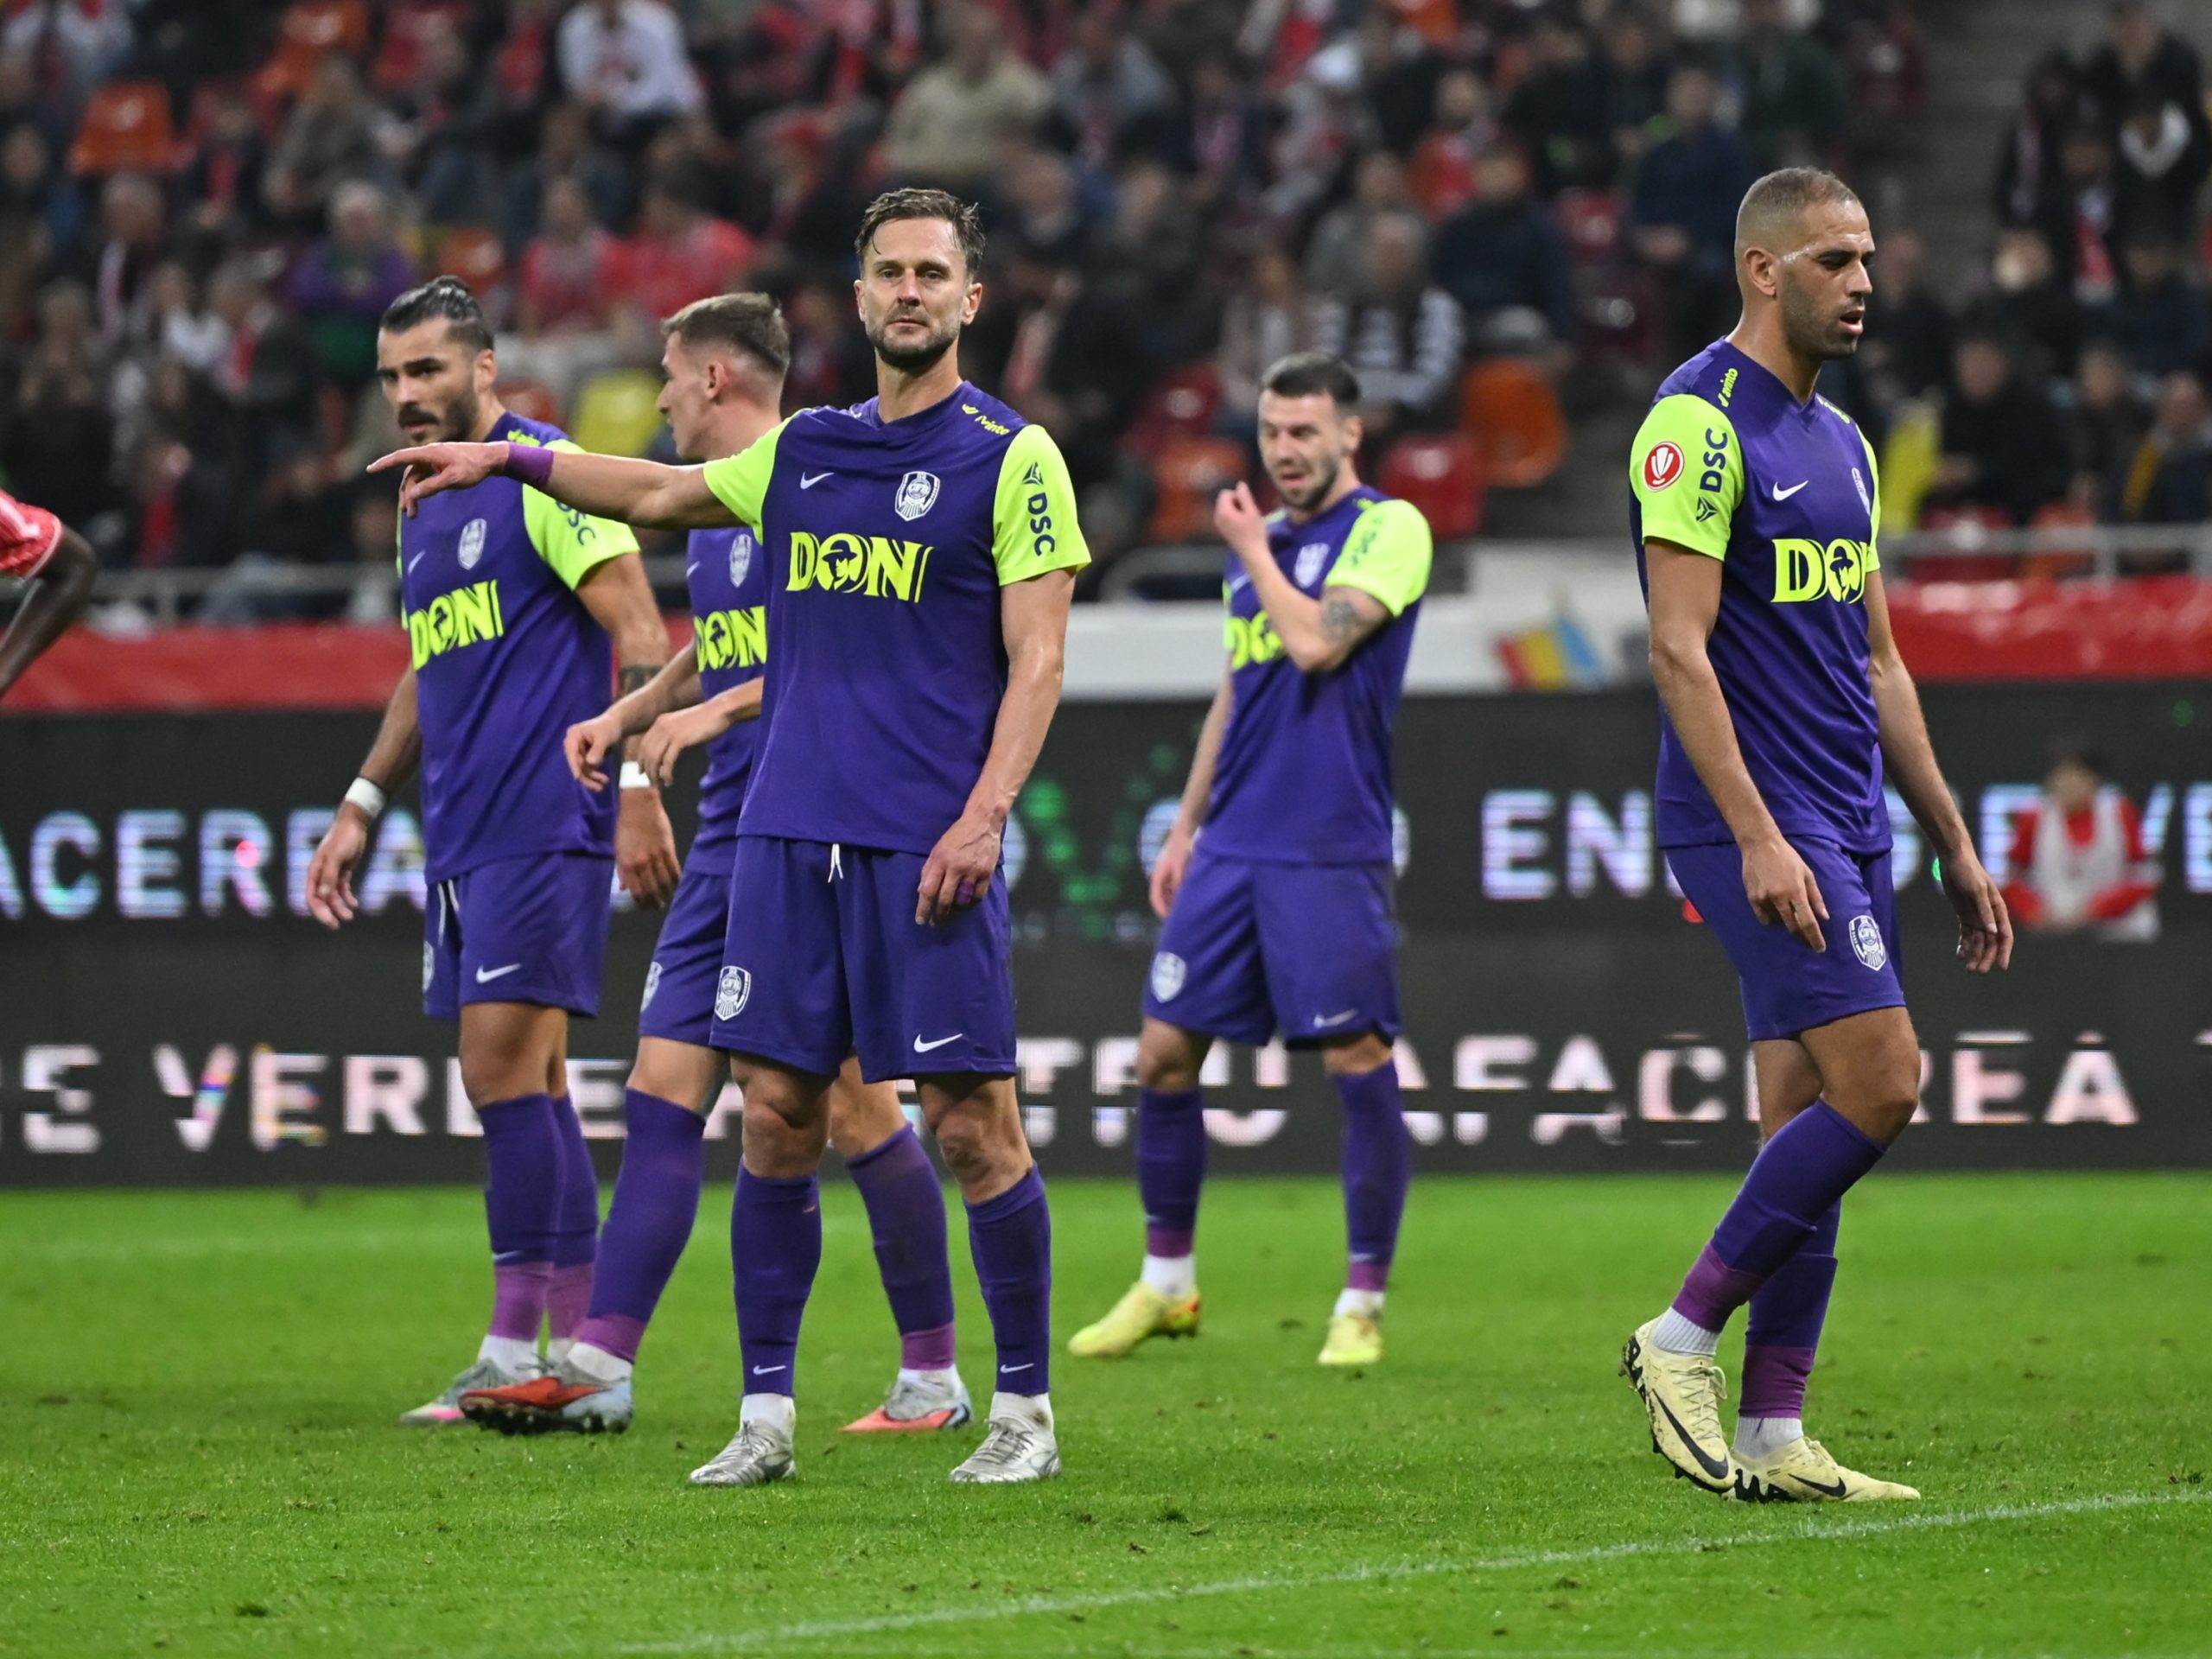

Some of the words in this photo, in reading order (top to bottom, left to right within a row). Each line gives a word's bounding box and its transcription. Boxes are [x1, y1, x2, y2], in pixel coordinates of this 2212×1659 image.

[1700, 428, 1728, 493] DSC
[1027, 492, 1056, 556] DSC
[1770, 537, 1868, 605] DO
